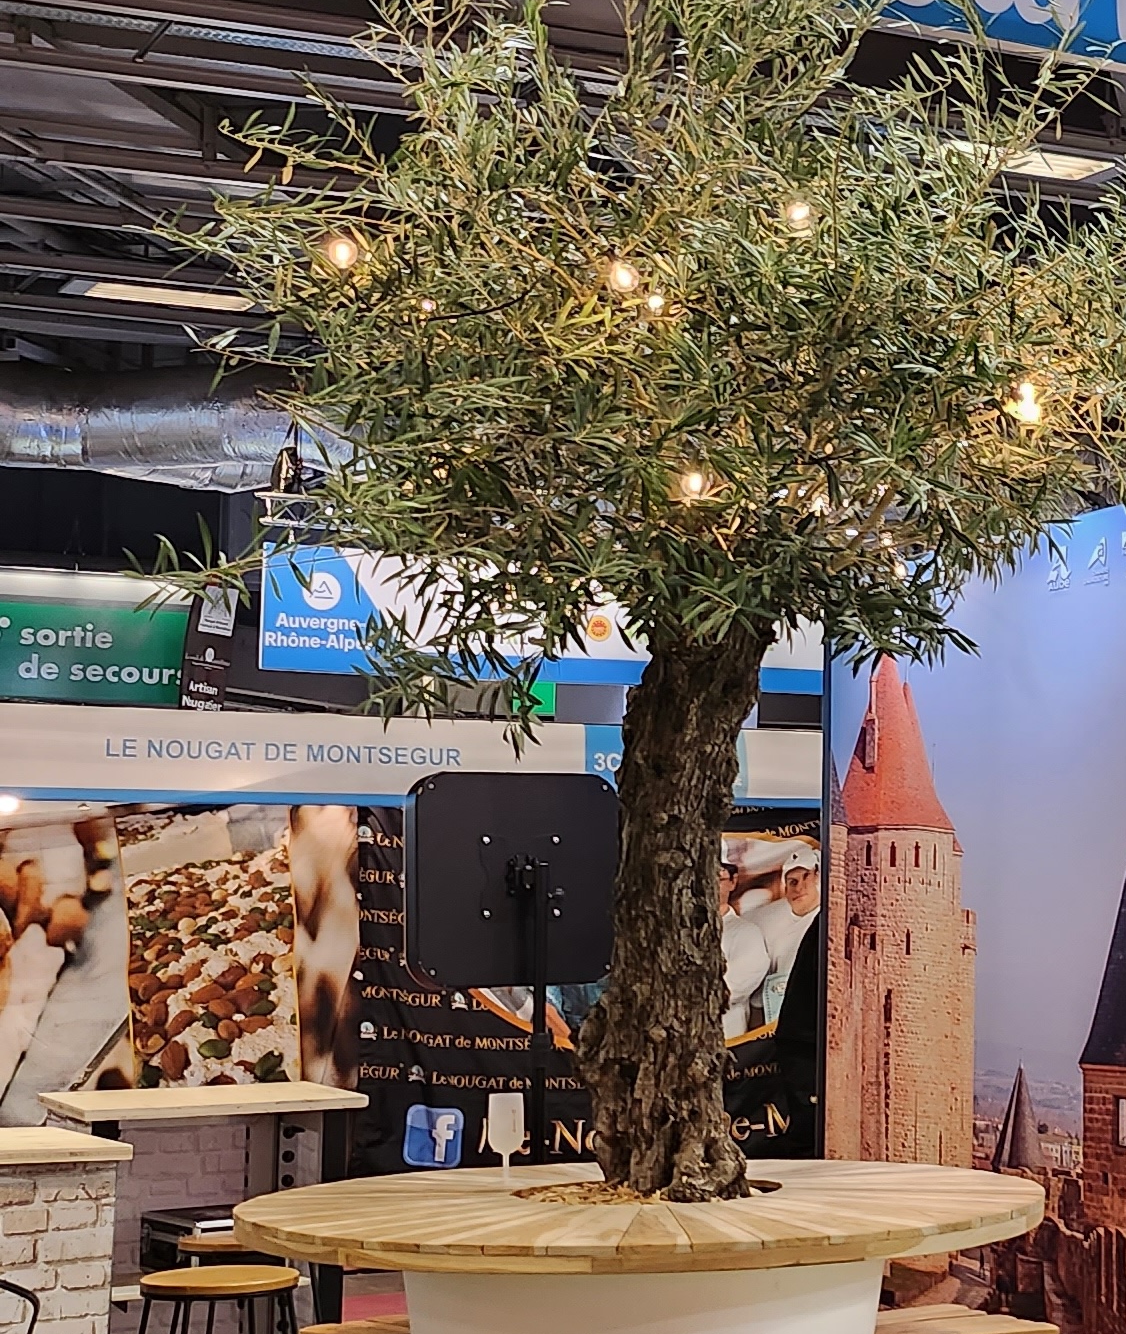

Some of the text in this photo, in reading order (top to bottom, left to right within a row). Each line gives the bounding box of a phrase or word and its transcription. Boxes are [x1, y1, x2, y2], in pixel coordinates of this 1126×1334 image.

[275, 612, 367, 633] Auvergne-
[19, 623, 114, 649] sortie
[18, 653, 60, 680] de
[105, 739, 462, 766] LE NOUGAT DE MONTSEGUR
[383, 1026, 399, 1040] Le
[455, 1035, 472, 1048] de
[509, 1074, 524, 1088] de
